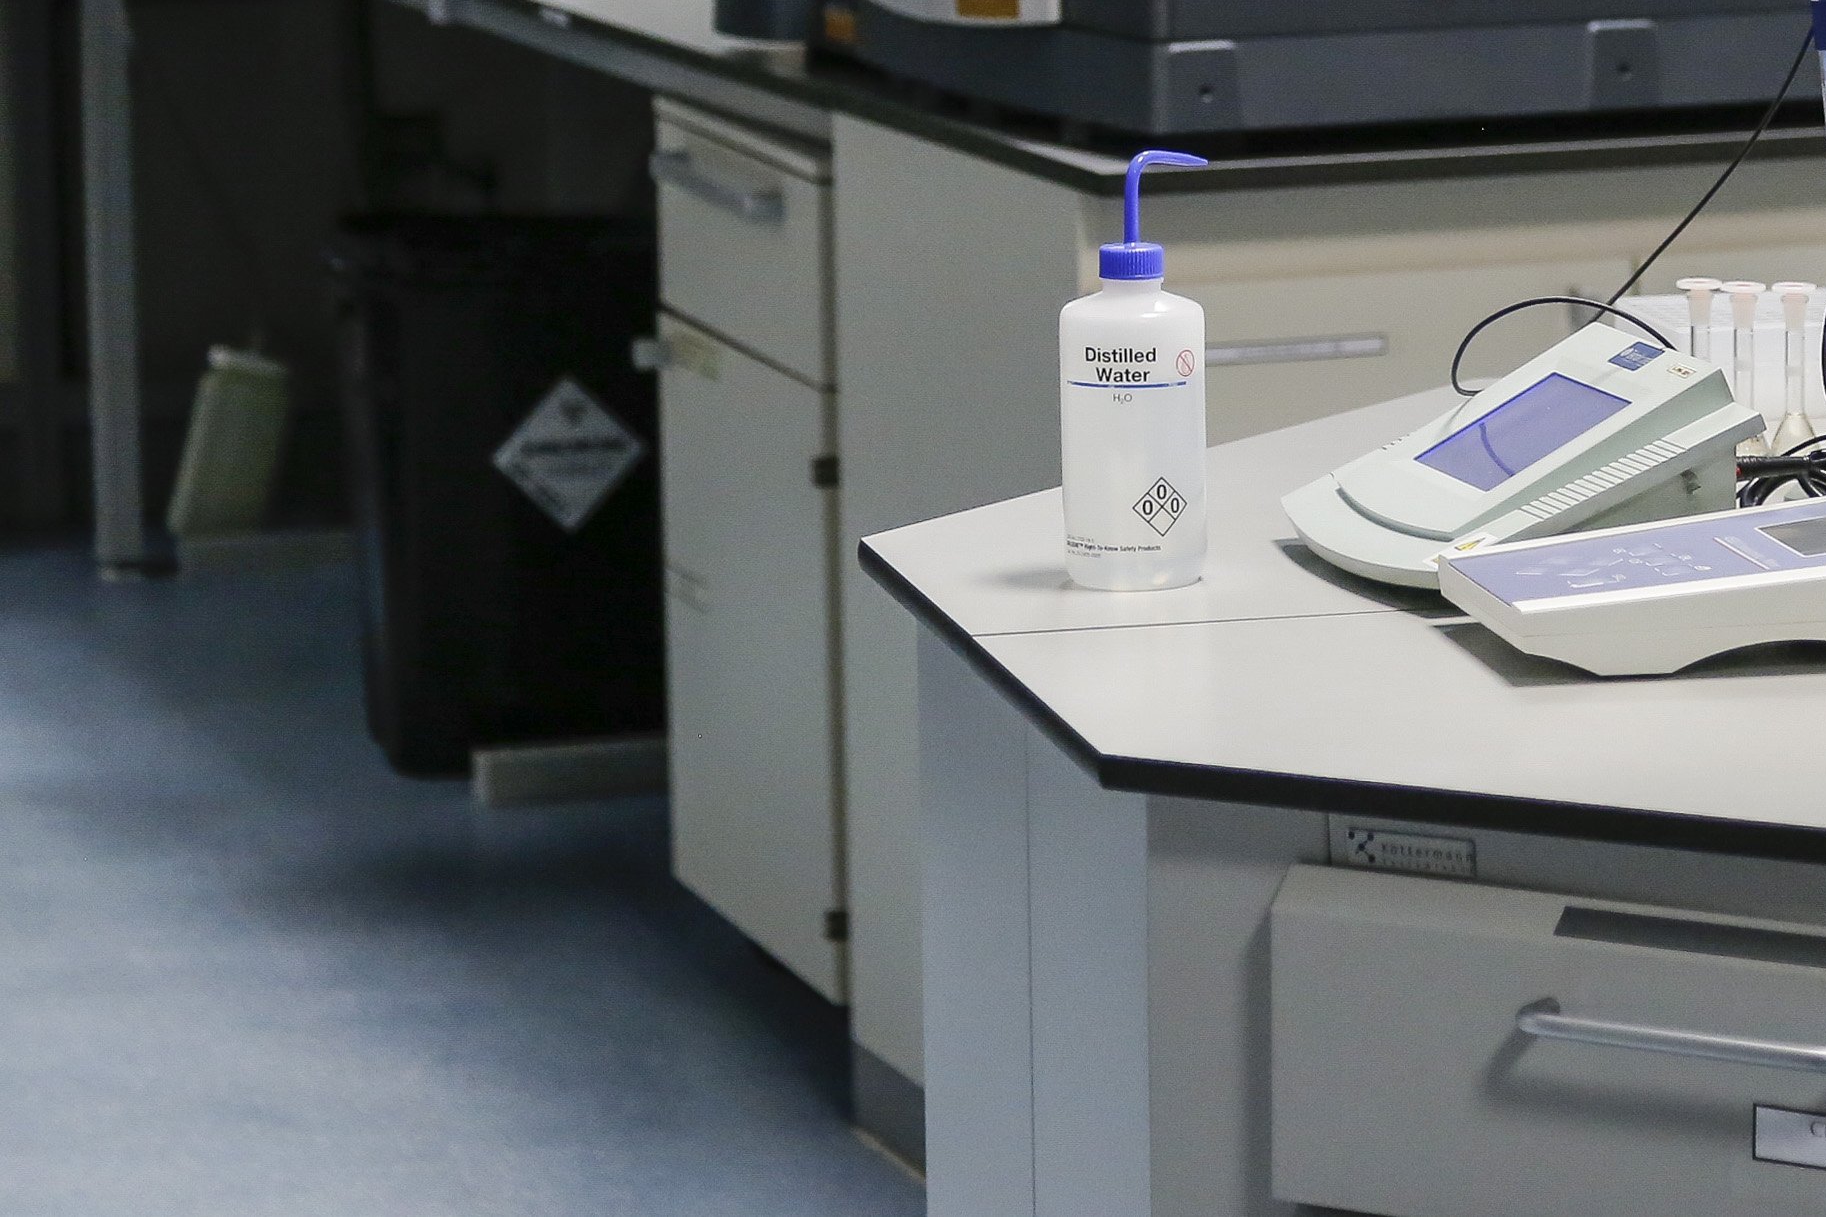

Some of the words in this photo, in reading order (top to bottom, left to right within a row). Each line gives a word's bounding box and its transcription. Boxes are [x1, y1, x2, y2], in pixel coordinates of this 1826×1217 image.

[1085, 347, 1157, 363] Distilled
[1096, 367, 1150, 382] Water
[1157, 484, 1167, 500] 0
[1142, 500, 1153, 515] 0
[1170, 497, 1180, 513] 0
